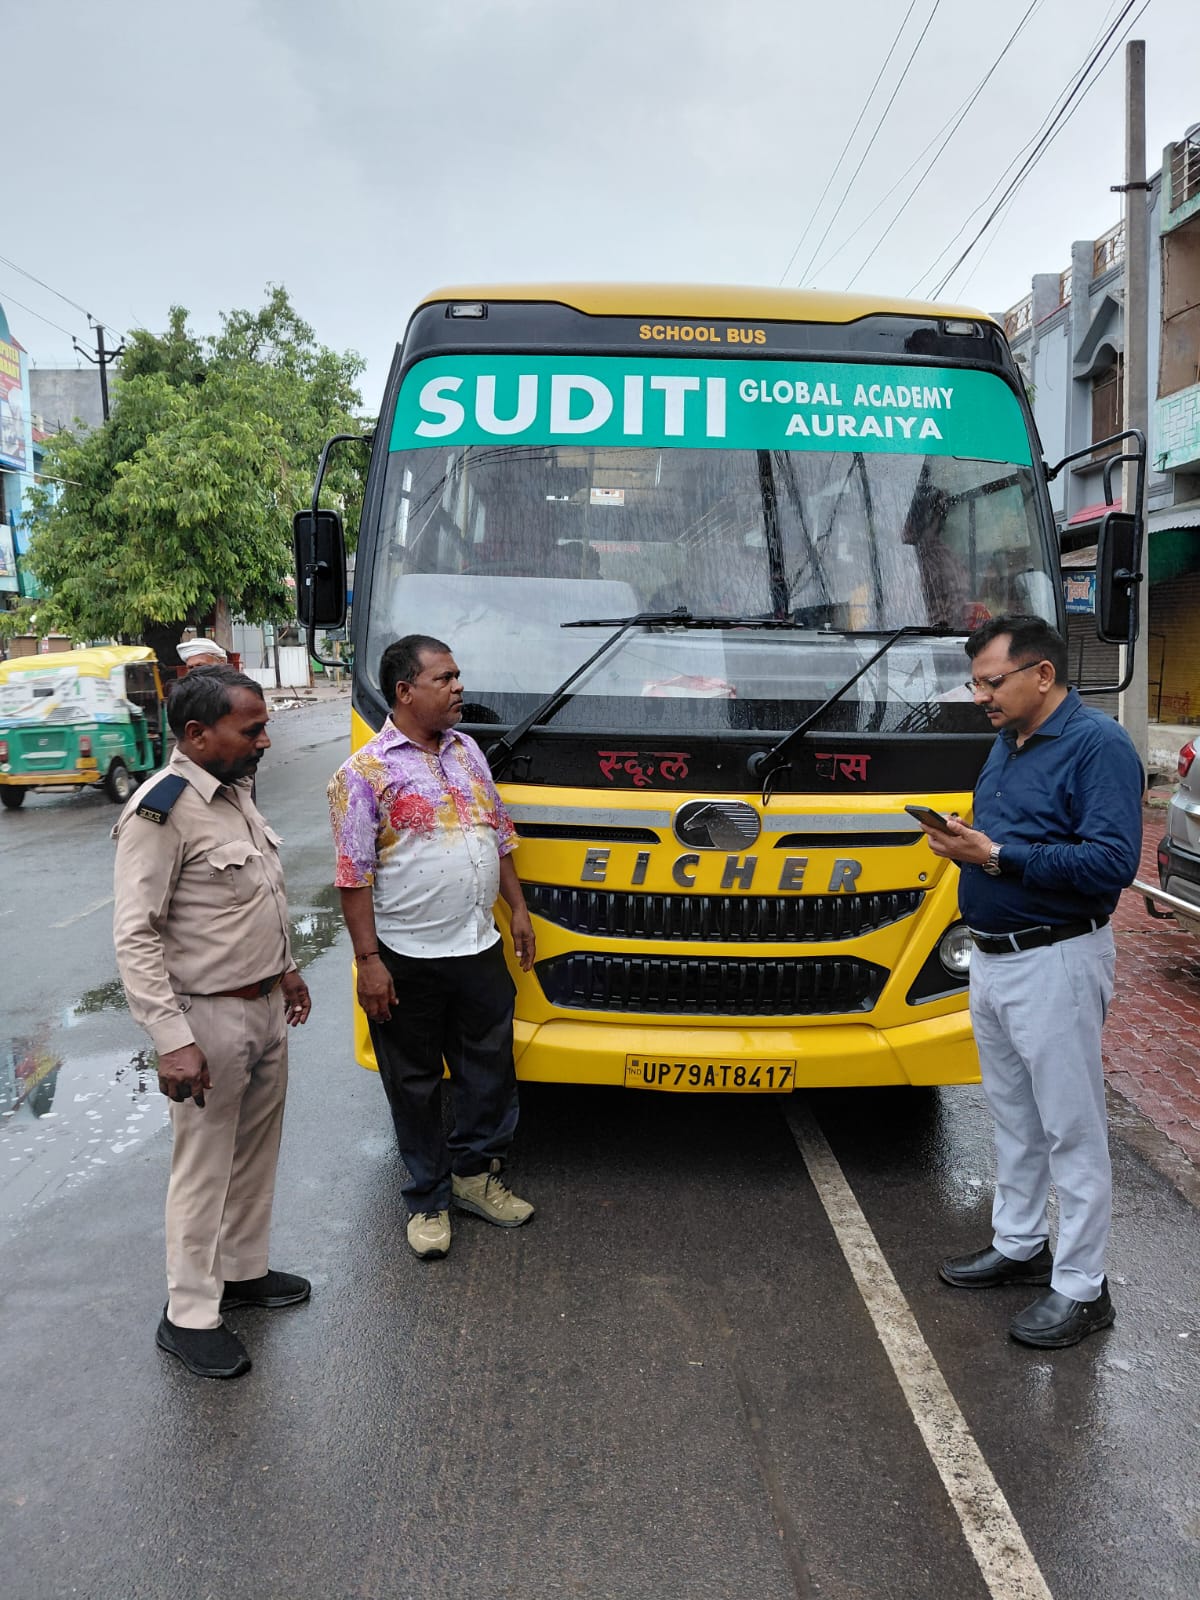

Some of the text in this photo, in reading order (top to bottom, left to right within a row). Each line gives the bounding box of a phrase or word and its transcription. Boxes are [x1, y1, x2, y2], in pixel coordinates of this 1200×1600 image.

[639, 324, 767, 344] SCHOOL BUS
[414, 374, 727, 438] SUDITI
[739, 379, 954, 409] GLOBAL ACADEMY
[785, 413, 943, 440] AURAIYA
[580, 847, 863, 893] EICHER
[643, 1062, 792, 1088] UP79AT8417
